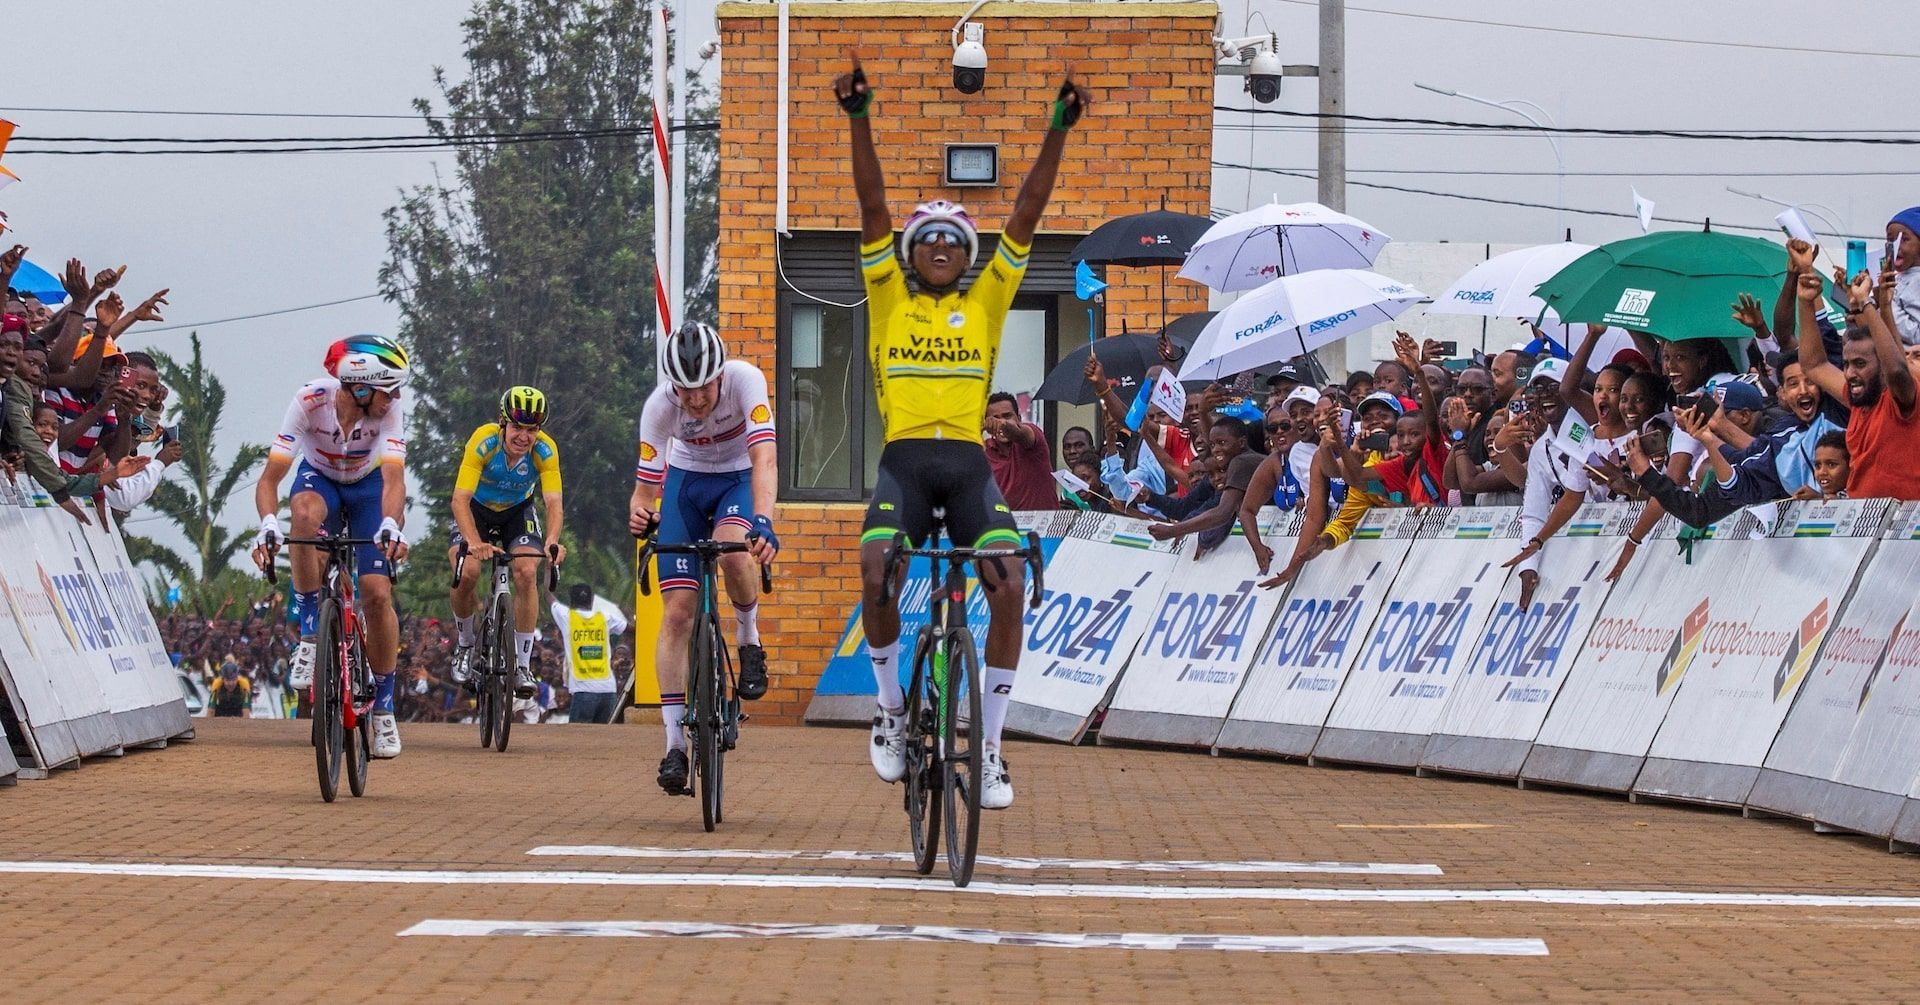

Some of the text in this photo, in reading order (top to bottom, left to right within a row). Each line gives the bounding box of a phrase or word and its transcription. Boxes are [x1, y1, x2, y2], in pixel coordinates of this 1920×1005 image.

[910, 334, 964, 349] VISIT
[888, 347, 982, 362] RWANDA
[573, 629, 605, 642] OFFICIEL
[1054, 667, 1106, 686] www.forzza.rw
[1187, 666, 1238, 684] www.forzza.rw
